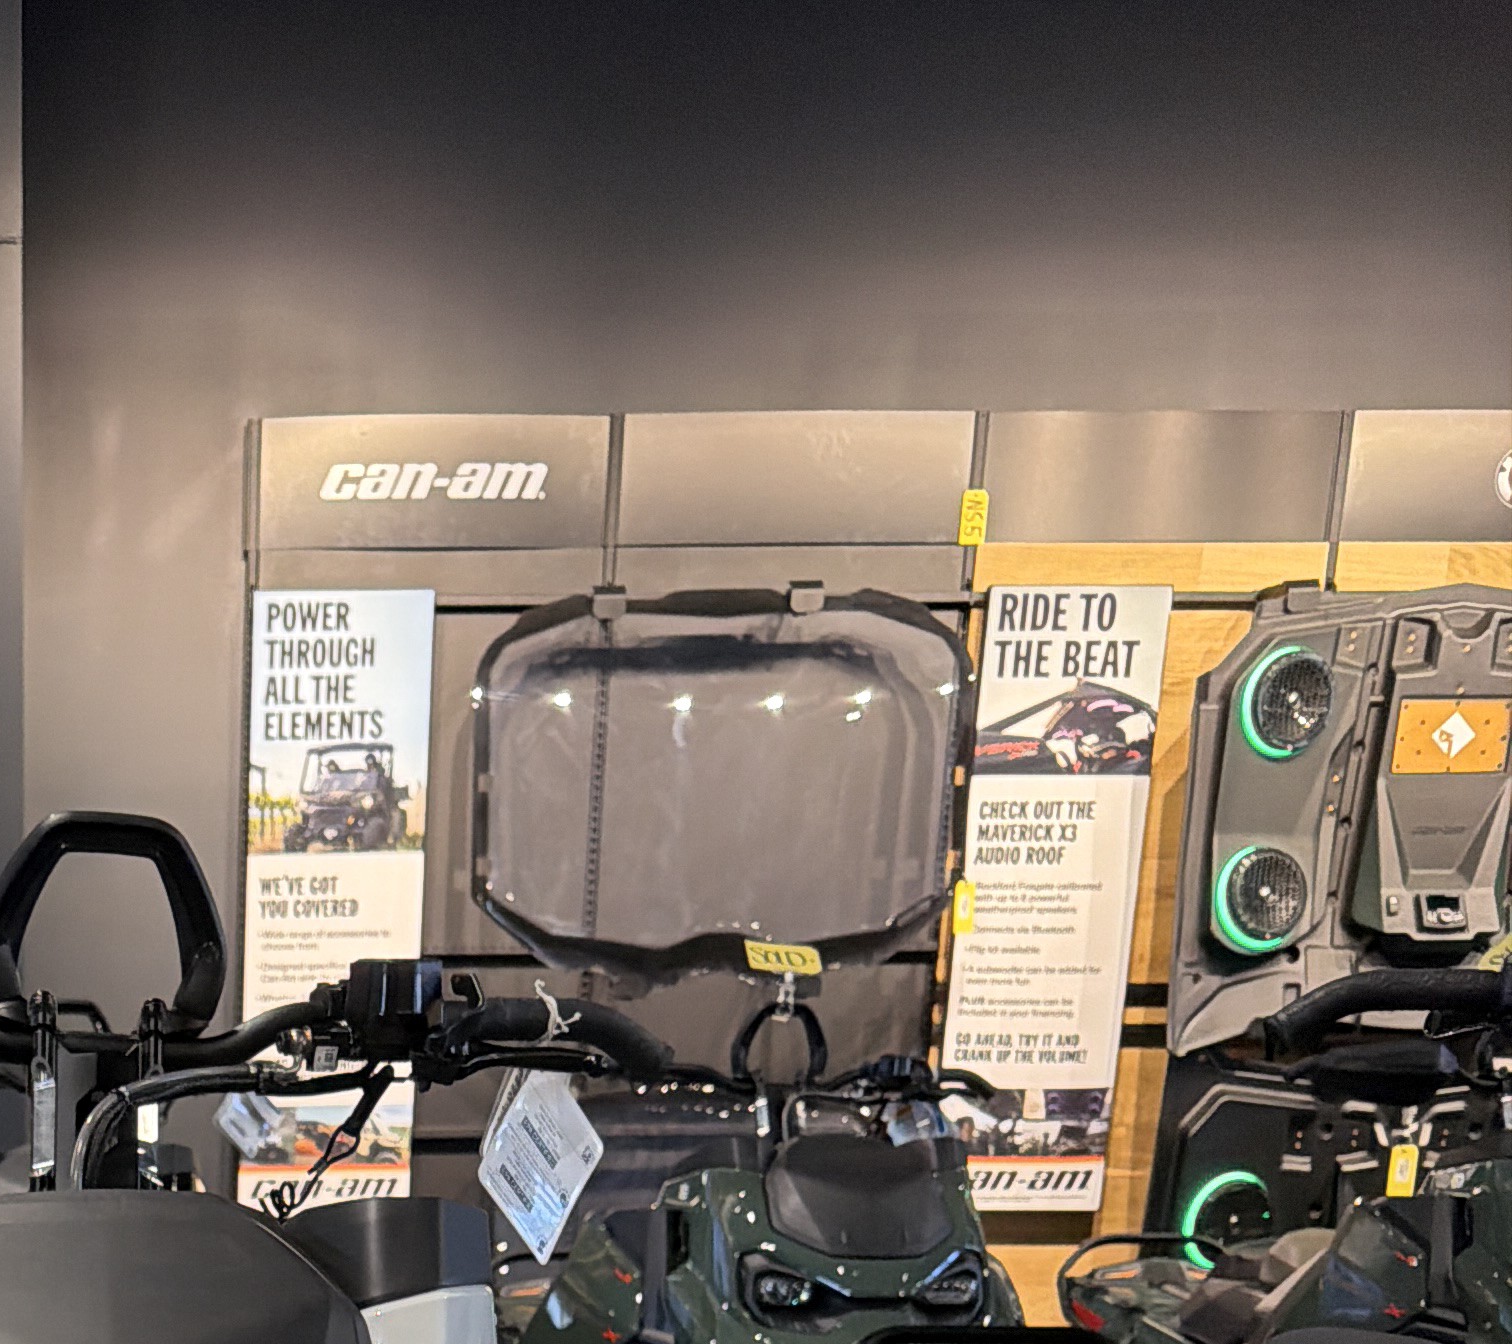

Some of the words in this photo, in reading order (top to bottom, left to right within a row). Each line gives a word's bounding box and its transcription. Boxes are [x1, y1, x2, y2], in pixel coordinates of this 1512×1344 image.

[320, 461, 548, 500] can-am
[266, 602, 351, 632] POWER
[997, 592, 1071, 632] RIDE
[1079, 592, 1117, 632] TO
[264, 637, 376, 669] THROUGH
[994, 640, 1053, 678] THE
[1061, 640, 1141, 678] BEAT
[265, 675, 306, 706] ALL
[310, 674, 356, 705] THE
[265, 710, 384, 740] ELEMENTS
[979, 801, 1029, 820] CHECK
[1033, 801, 1062, 820] OUT
[1067, 800, 1097, 820] THE
[976, 823, 1054, 844] MAVERICK
[1057, 823, 1078, 843] X3
[974, 846, 1021, 866] AUDIO
[1025, 846, 1066, 865] ROOF
[309, 875, 339, 896] GOT
[258, 898, 288, 918] YOU
[292, 897, 360, 918] COVERED
[955, 1032, 971, 1047] GO
[1056, 1032, 1080, 1047] AND
[954, 1049, 992, 1064] CRANK
[996, 1049, 1011, 1063] UP
[1014, 1049, 1034, 1064] THE
